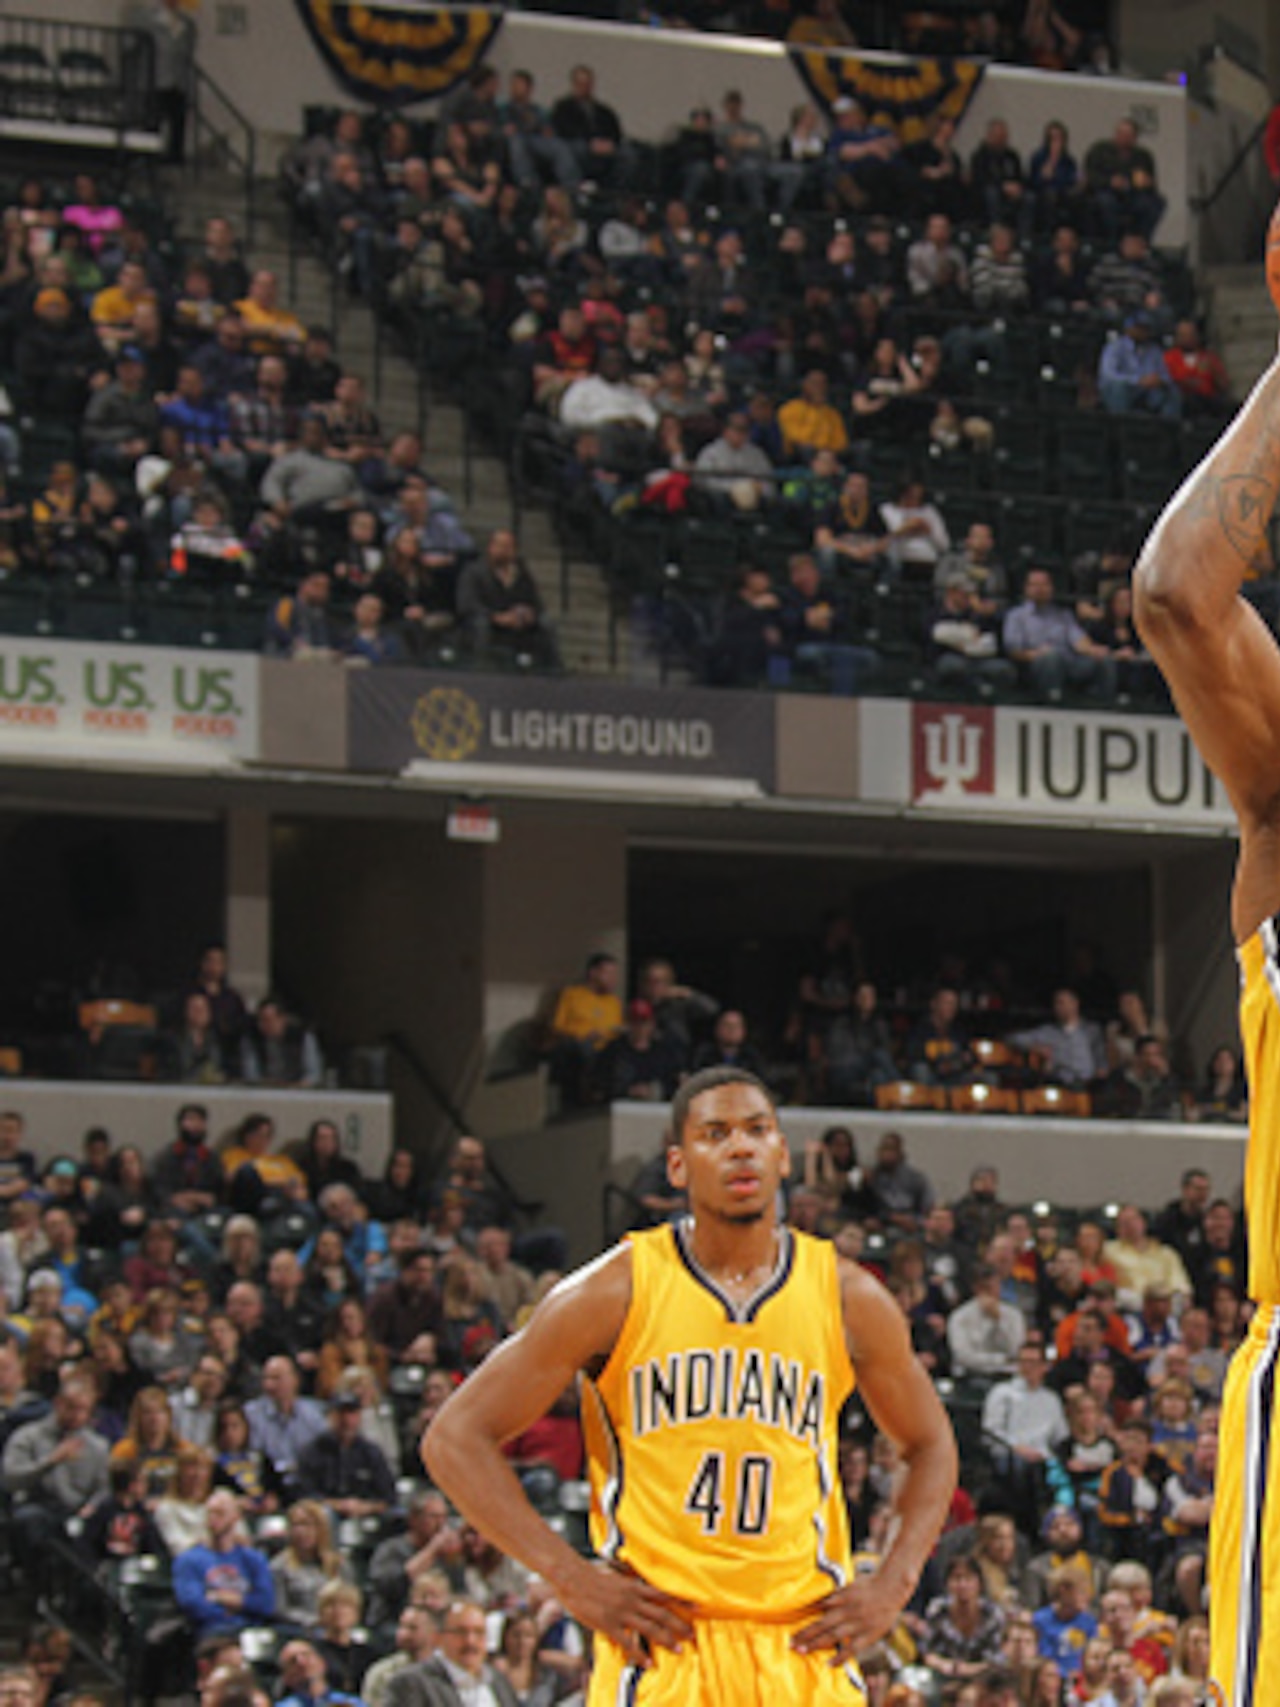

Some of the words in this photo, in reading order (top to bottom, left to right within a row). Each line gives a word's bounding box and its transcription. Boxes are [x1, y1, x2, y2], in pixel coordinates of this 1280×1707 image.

[489, 709, 714, 758] LIGHTBOUND
[630, 1347, 825, 1449] INDIANA
[684, 1451, 771, 1535] 40
